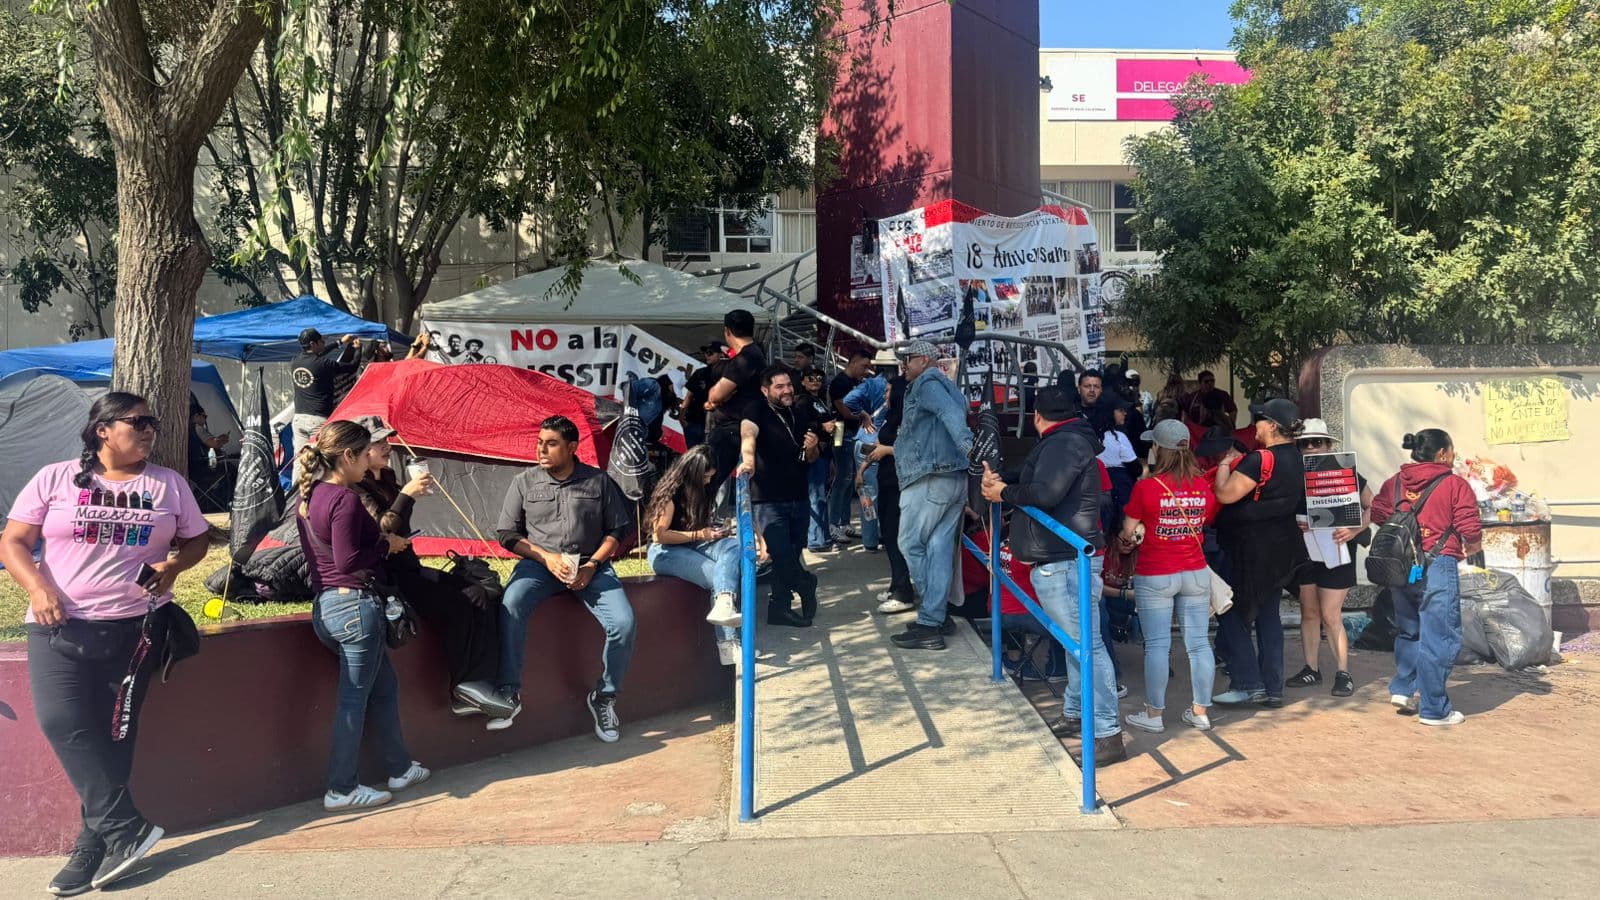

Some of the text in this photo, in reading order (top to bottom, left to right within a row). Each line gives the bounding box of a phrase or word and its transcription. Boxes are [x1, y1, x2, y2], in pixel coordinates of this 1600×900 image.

[1071, 94, 1086, 103] SE
[967, 242, 983, 269] 18
[511, 329, 558, 351] NO
[568, 333, 584, 350] a
[594, 327, 617, 349] la
[624, 333, 670, 375] Ley
[74, 506, 154, 522] Maestra
